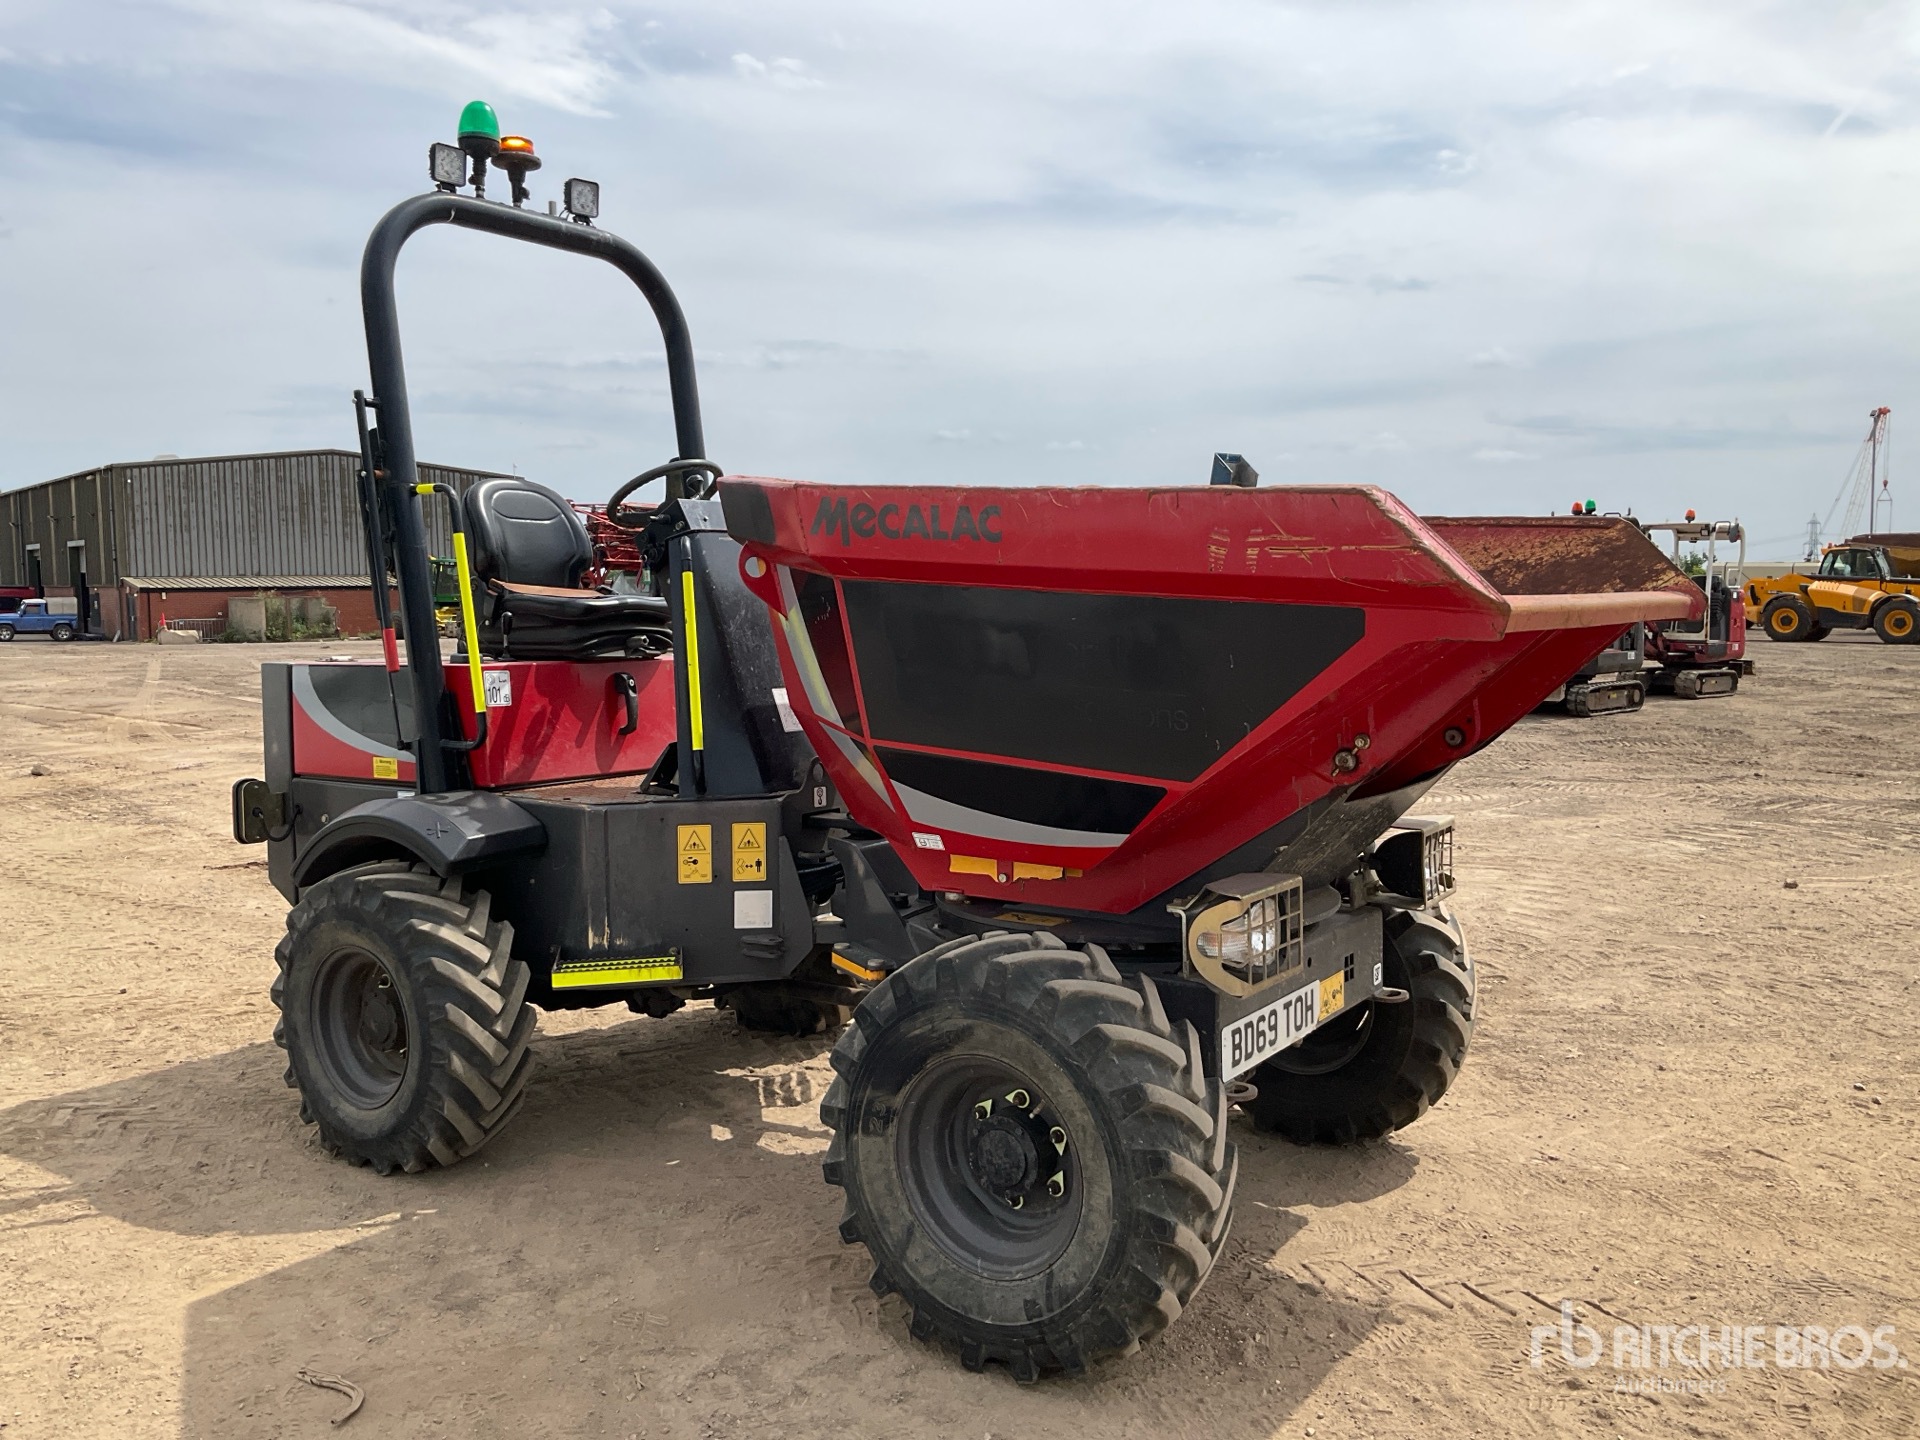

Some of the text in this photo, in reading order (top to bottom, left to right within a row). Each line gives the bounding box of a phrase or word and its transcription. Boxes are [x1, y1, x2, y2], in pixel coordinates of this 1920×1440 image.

[487, 686, 502, 703] 101
[1231, 988, 1315, 1068] BD69 TOH
